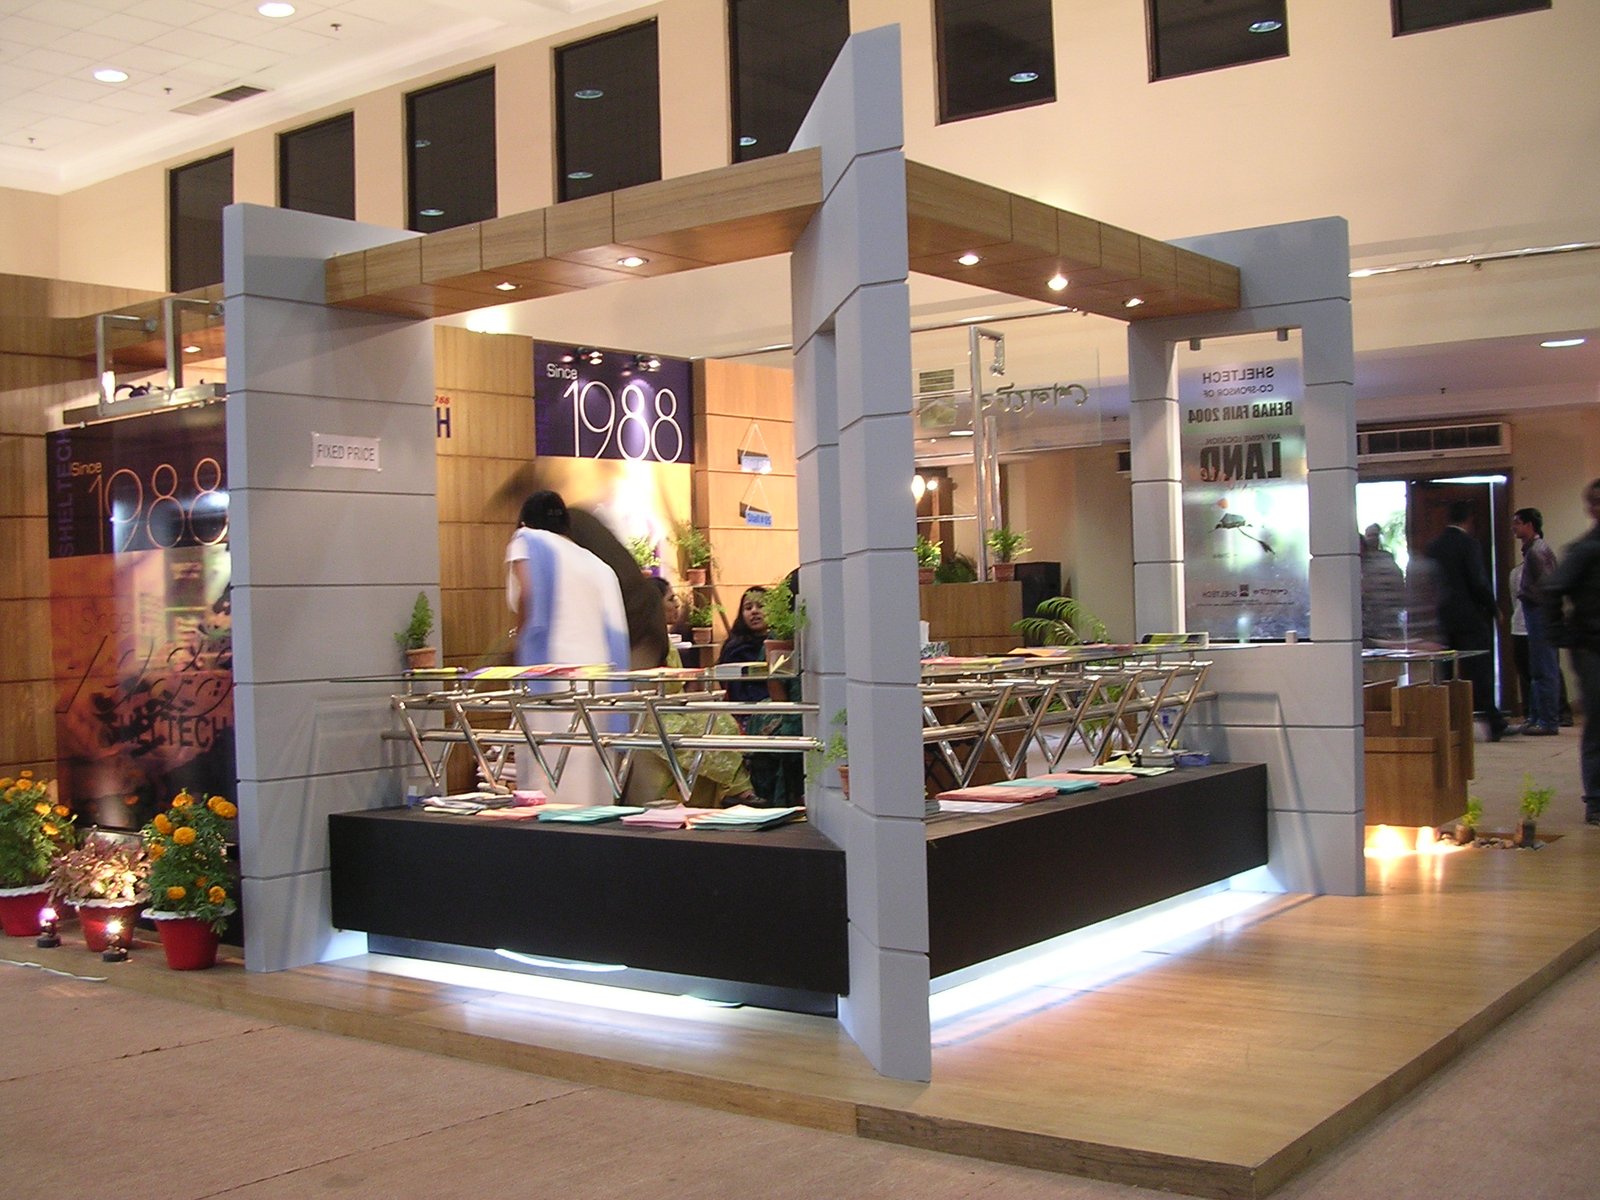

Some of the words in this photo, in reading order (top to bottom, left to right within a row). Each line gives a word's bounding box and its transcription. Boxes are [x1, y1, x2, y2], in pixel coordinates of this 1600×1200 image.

[546, 363, 578, 380] Since
[563, 380, 683, 463] 1988
[316, 443, 345, 459] FIXED
[347, 446, 375, 462] PRICE
[71, 461, 102, 477] Since
[89, 457, 228, 553] 1988
